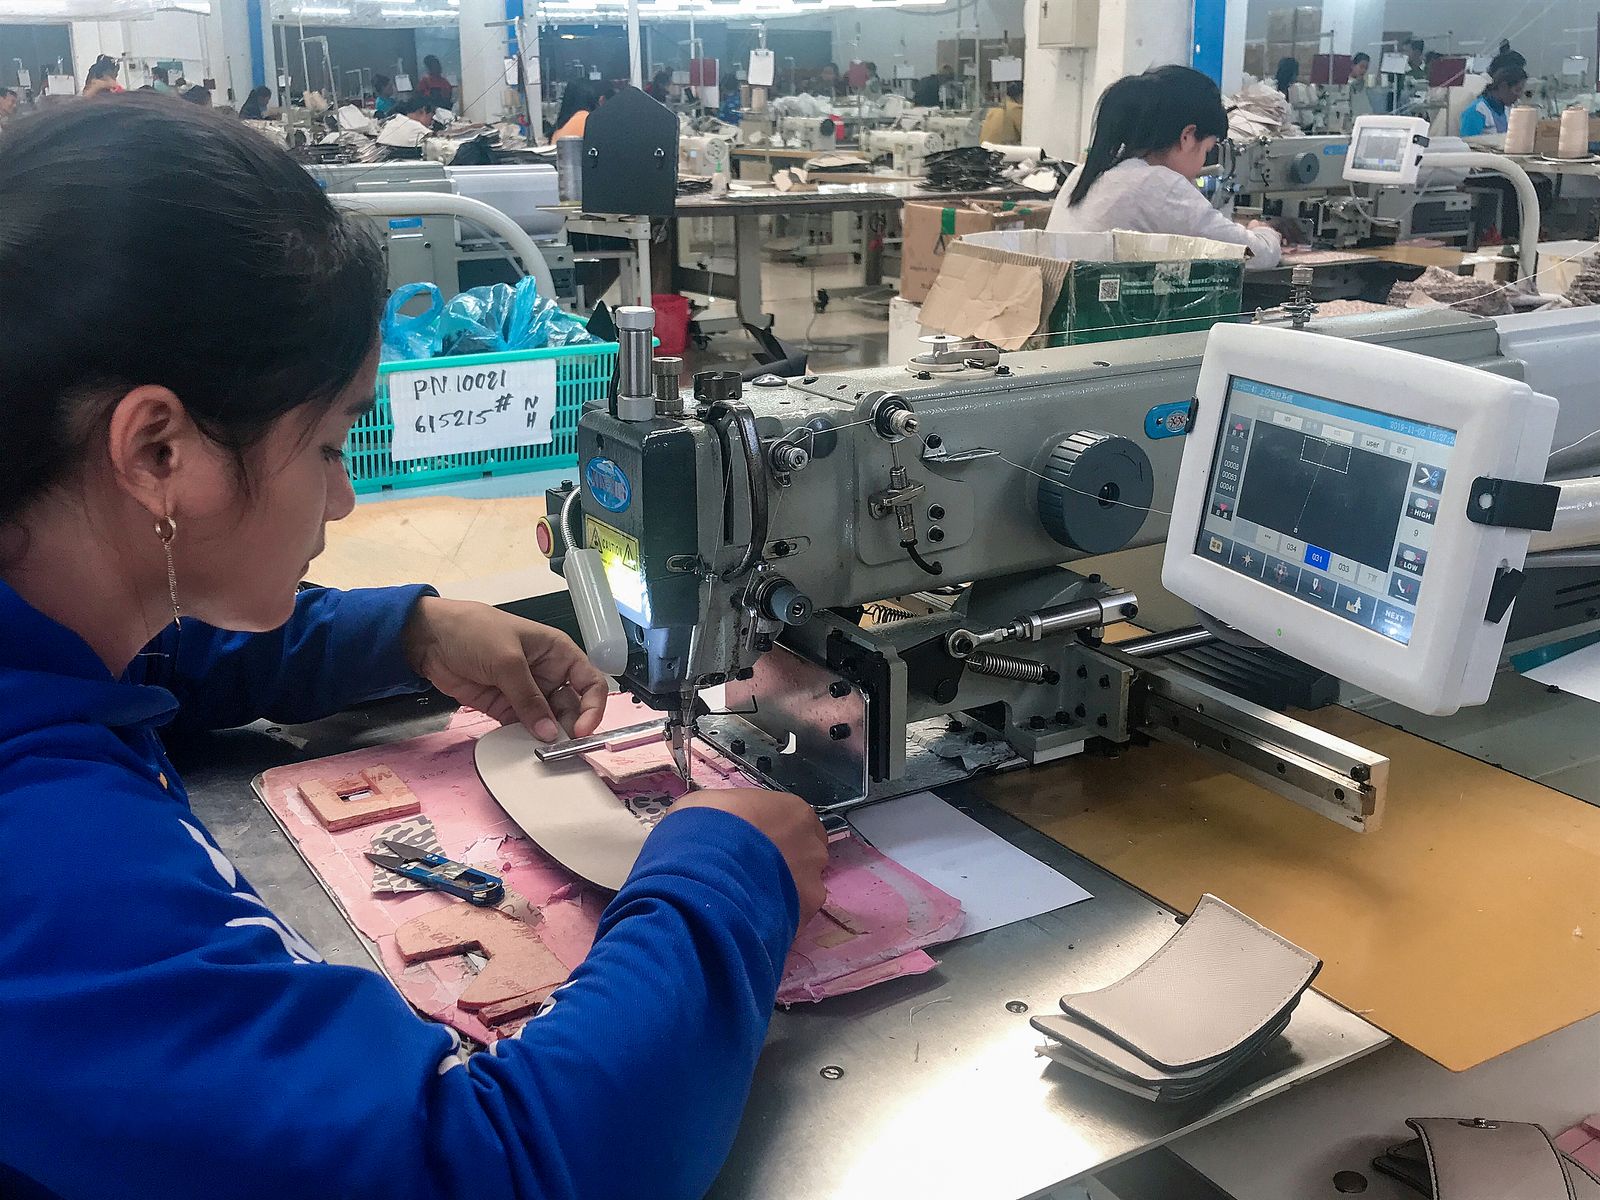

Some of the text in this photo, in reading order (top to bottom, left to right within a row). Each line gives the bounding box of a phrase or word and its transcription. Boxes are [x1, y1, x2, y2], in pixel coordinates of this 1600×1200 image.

[525, 395, 539, 411] N
[527, 412, 537, 428] H
[1366, 440, 1380, 448] user
[1413, 508, 1431, 520] HIGH
[1413, 529, 1419, 537] 9
[1403, 561, 1418, 572] LOW
[1385, 609, 1405, 622] NEXT
